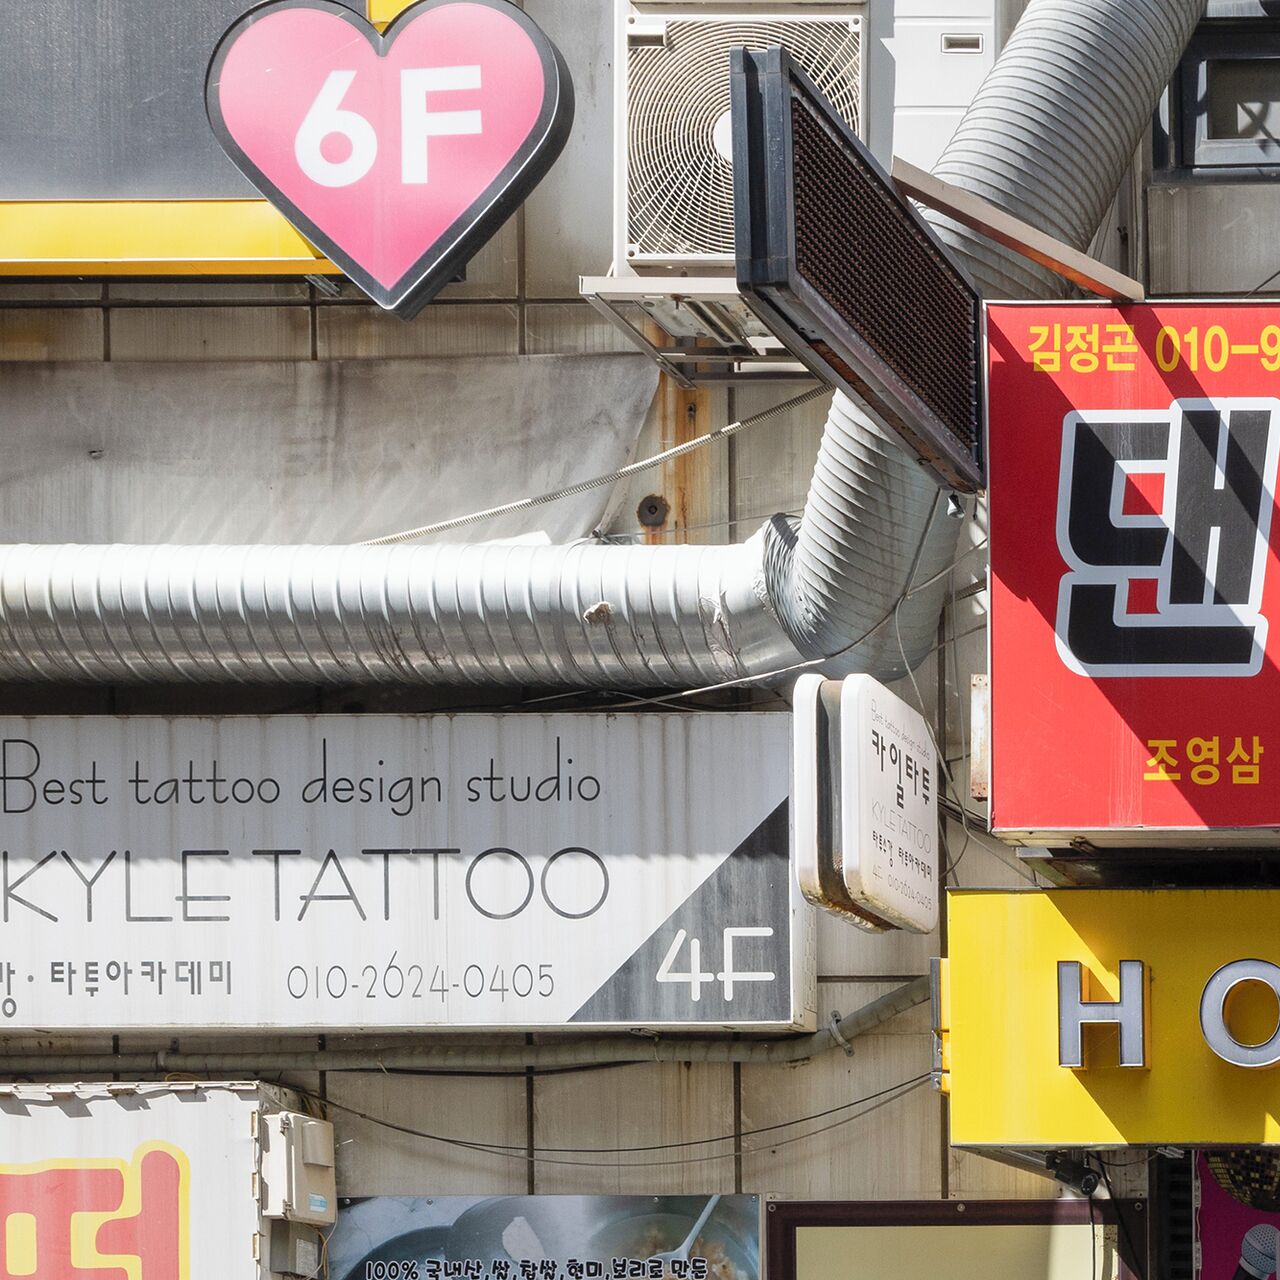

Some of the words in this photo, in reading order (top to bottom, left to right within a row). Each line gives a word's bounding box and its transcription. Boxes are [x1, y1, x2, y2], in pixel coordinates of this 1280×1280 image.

[295, 64, 482, 187] 6F
[1028, 323, 1138, 375] 김정곤
[0, 738, 107, 813] Best
[128, 761, 281, 806] tattoo
[302, 738, 443, 816] design
[467, 736, 601, 805] studio
[872, 729, 929, 810] 카일타투
[1144, 736, 1264, 787] 조영삼
[50, 960, 232, 998] 타투아카데미
[287, 951, 556, 1001] 010-2624-0405
[656, 926, 775, 1003] 4F
[365, 1260, 418, 1280] 100%
